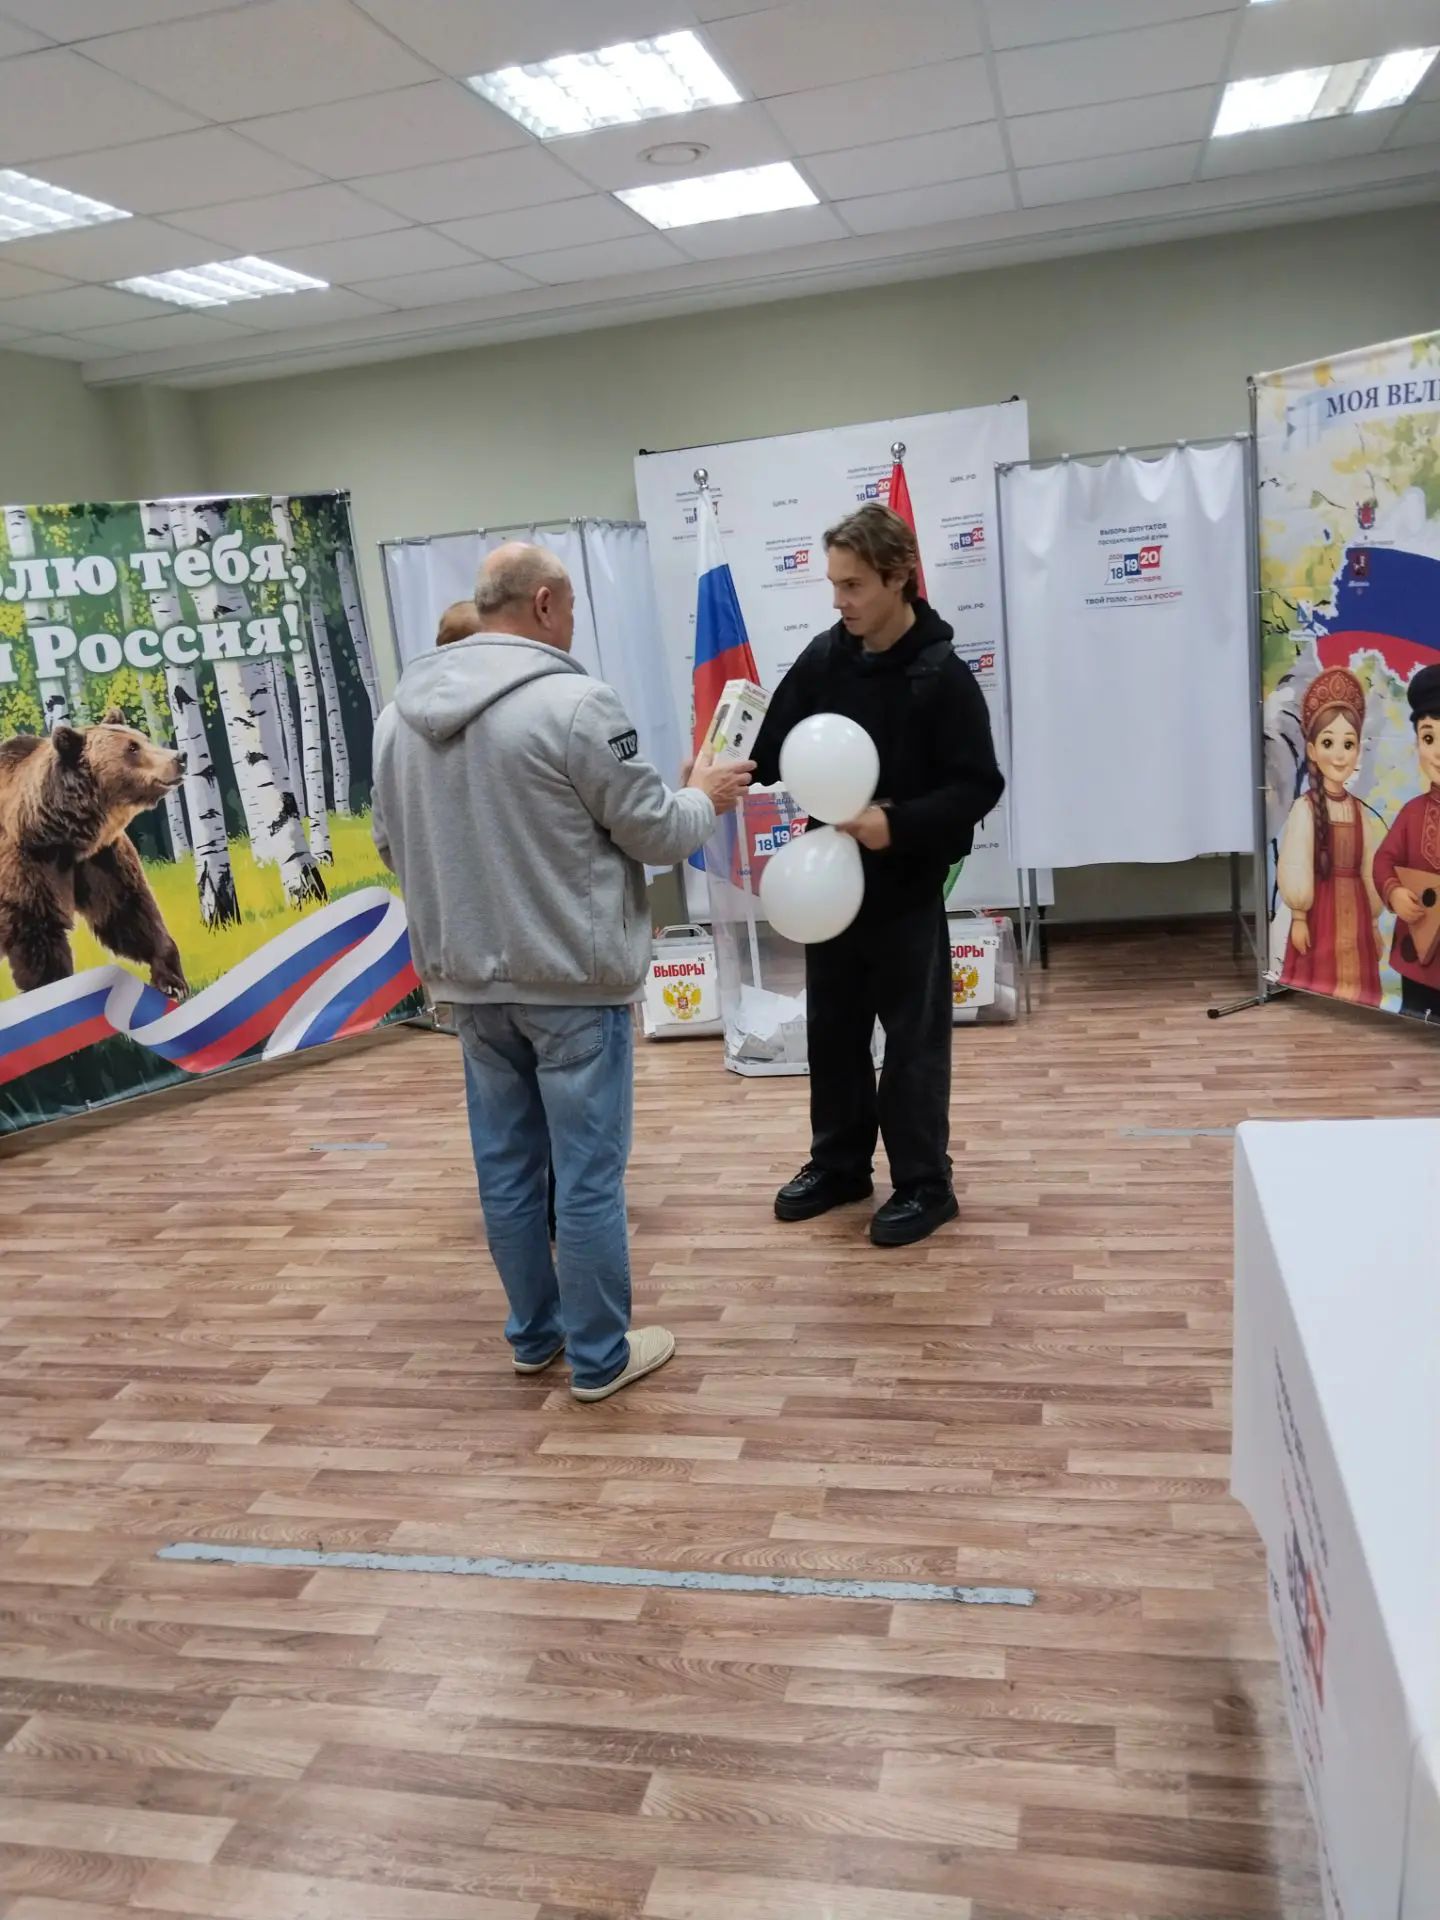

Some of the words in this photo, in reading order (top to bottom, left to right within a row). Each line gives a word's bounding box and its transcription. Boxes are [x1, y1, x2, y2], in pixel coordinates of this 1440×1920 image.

[1326, 387, 1379, 418] МОЯ
[1387, 379, 1440, 406] ВЕЛ
[878, 481, 890, 490] 20
[0, 555, 118, 602] лю
[130, 529, 307, 590] тебя,
[1111, 567, 1123, 580] 18
[1125, 559, 1138, 572] 19
[1140, 551, 1159, 564] 20
[27, 603, 303, 679] Россия!
[980, 656, 993, 666] 20
[758, 839, 773, 851] 18
[774, 830, 790, 844] 19
[950, 945, 984, 959] БОРЫ
[653, 963, 705, 978] ВЫБОРЫ
